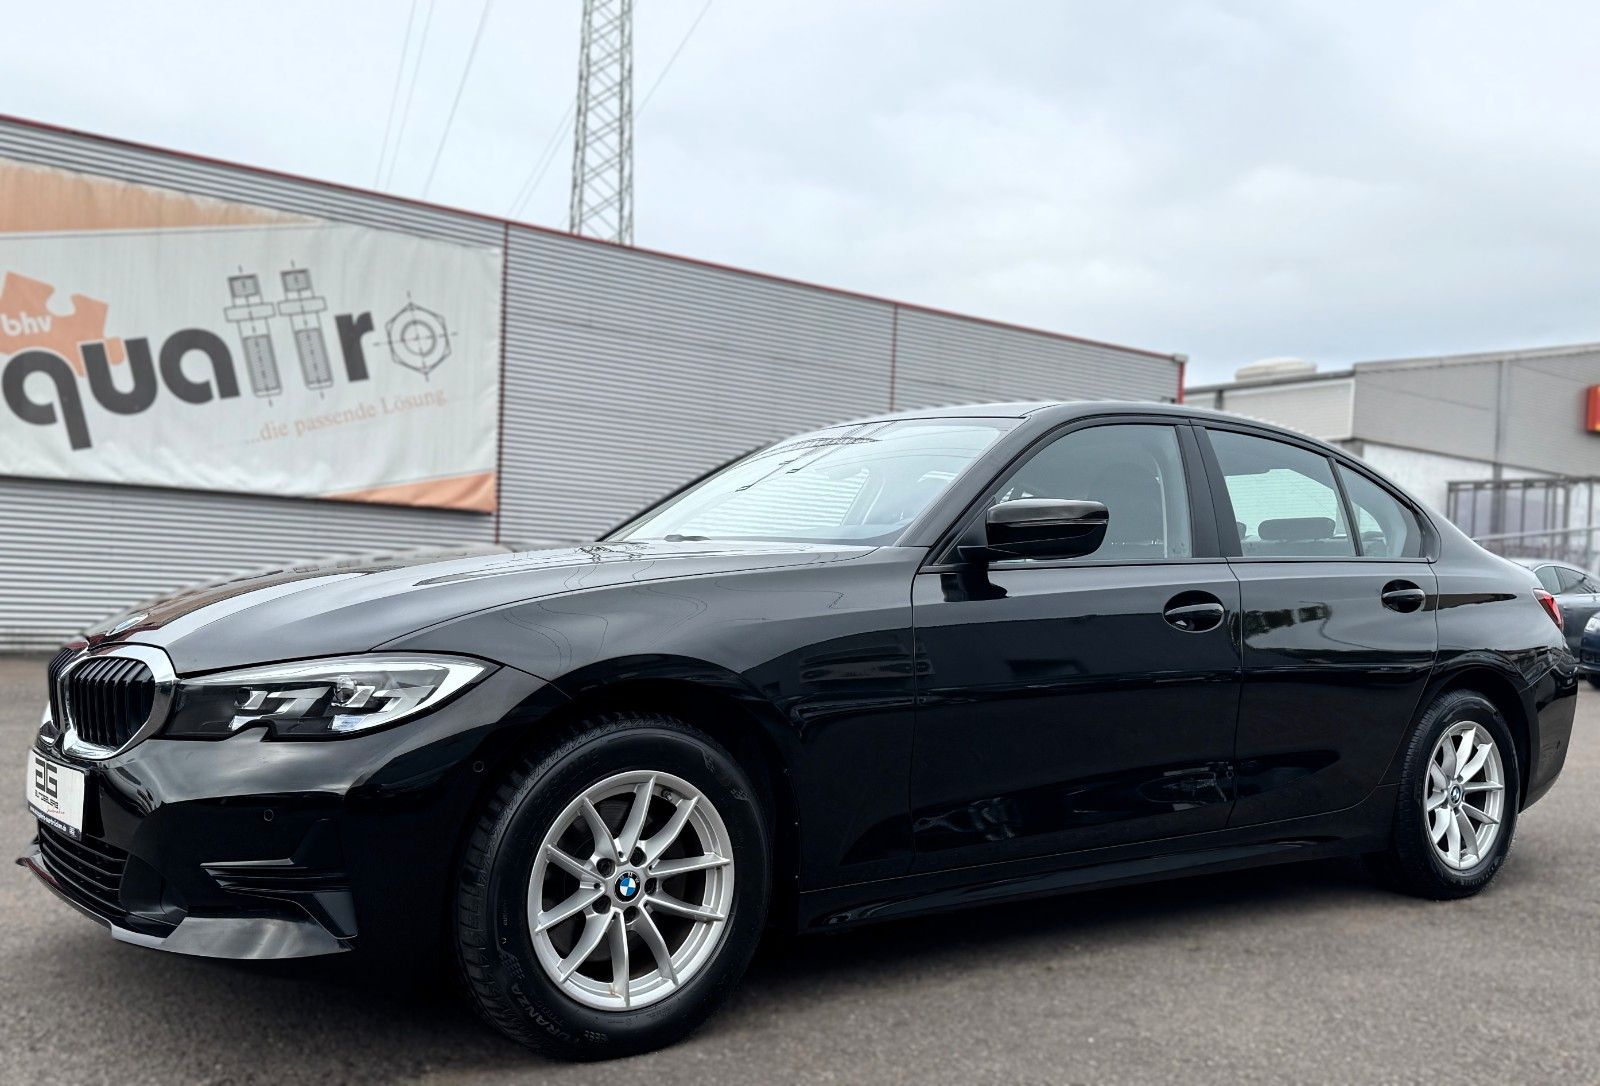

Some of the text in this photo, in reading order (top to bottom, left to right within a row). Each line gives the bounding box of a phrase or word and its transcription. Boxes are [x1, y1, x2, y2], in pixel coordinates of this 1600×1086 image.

[1, 311, 51, 336] bhv
[294, 402, 376, 437] passende
[381, 388, 447, 415] Lösung
